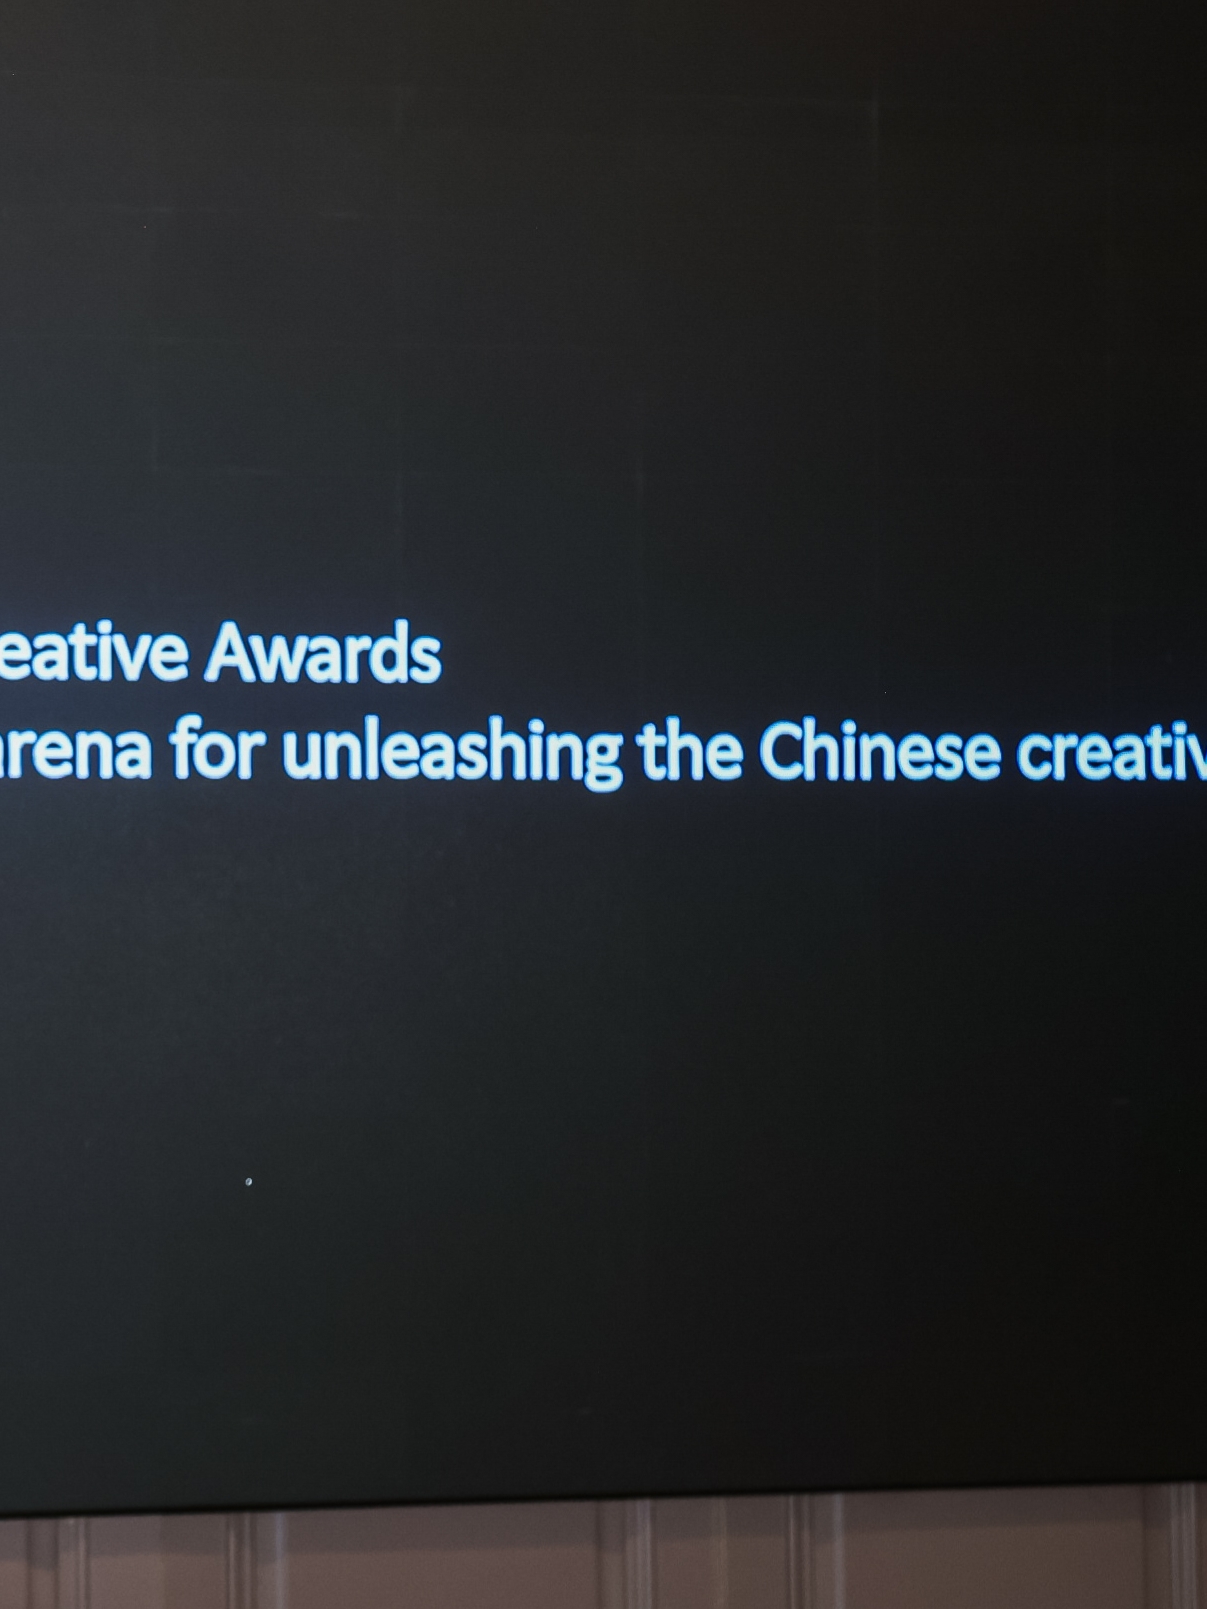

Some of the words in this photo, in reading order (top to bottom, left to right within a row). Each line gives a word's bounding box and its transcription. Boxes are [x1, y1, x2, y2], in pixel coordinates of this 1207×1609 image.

[203, 618, 441, 685] Awards
[168, 714, 266, 781] for
[282, 714, 624, 792] unleashing
[635, 716, 743, 782] the
[760, 717, 1002, 782] Chinese
